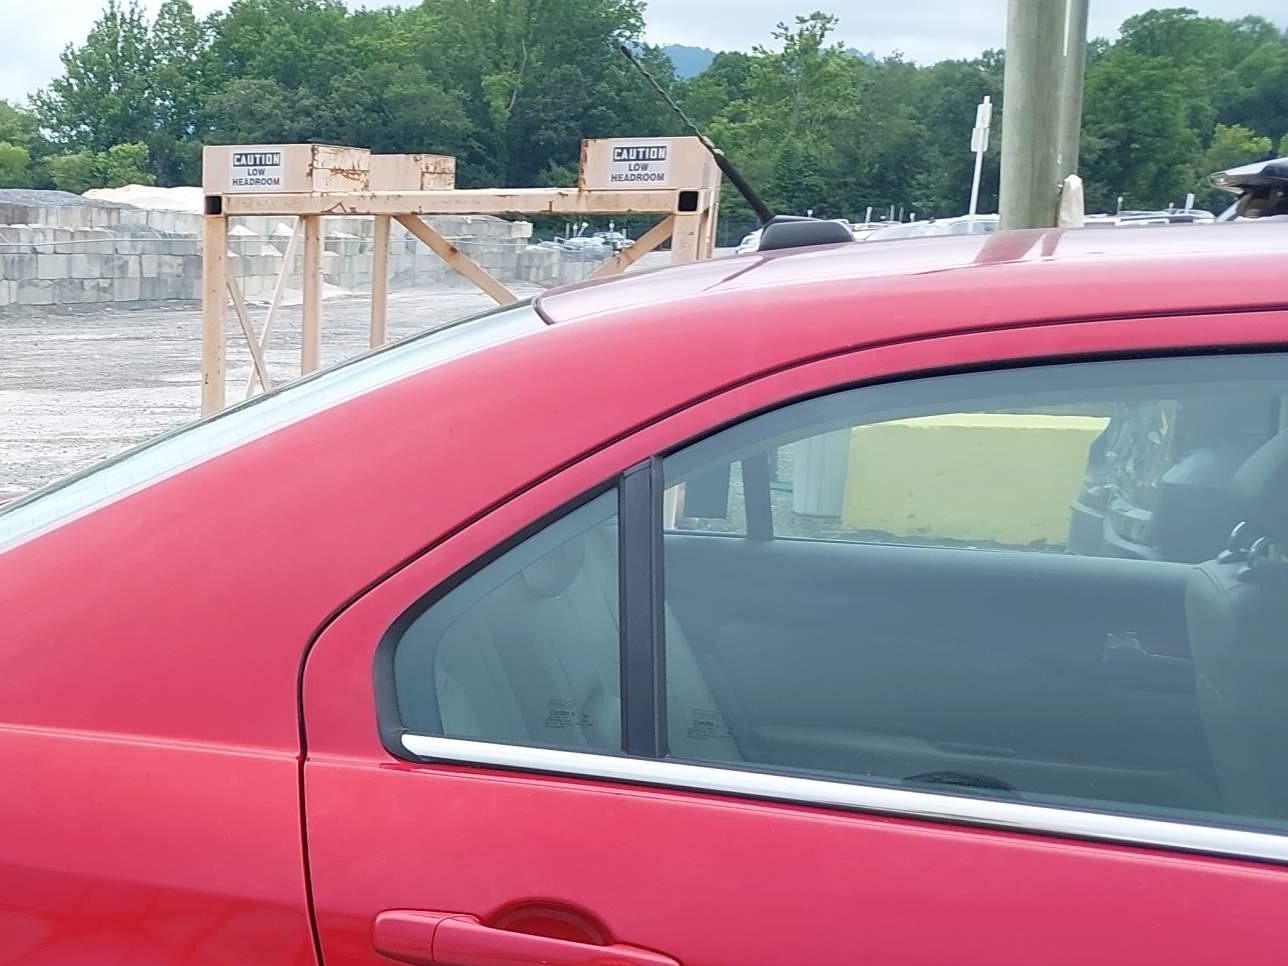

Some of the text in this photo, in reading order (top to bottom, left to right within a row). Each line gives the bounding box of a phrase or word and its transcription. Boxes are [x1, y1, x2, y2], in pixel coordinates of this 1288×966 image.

[613, 147, 666, 160] CAUTION
[233, 153, 280, 166] CAUTION
[628, 163, 649, 171] LOW
[247, 168, 265, 176] LOW
[232, 177, 280, 186] HEADROOM
[611, 173, 665, 182] HEADROOM
